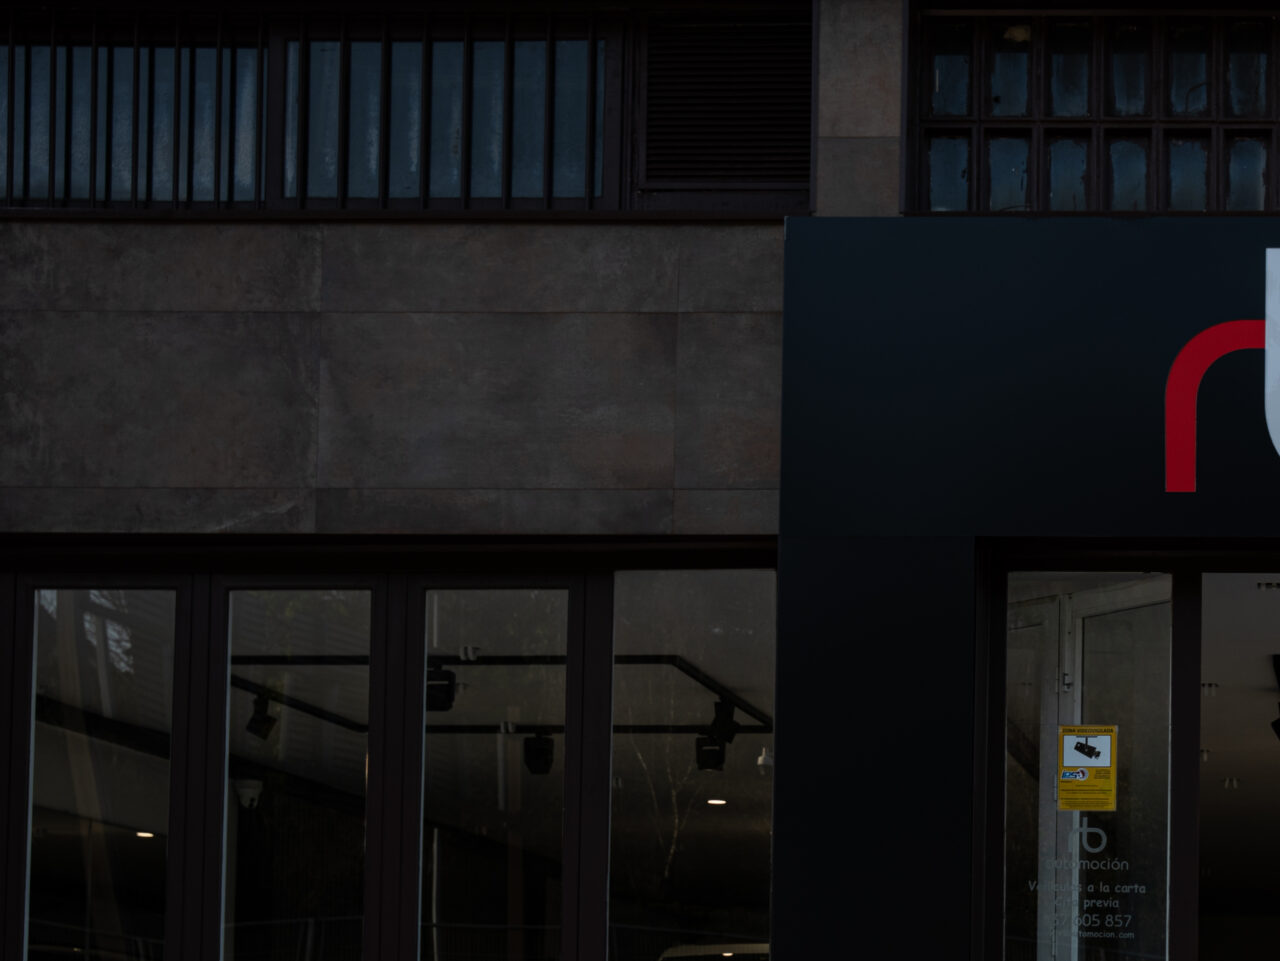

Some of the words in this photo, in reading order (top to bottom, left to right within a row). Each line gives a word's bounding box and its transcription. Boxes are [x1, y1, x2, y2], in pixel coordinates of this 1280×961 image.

[1087, 884, 1095, 892] a
[1100, 882, 1110, 893] la
[1114, 884, 1146, 894] carta
[1084, 897, 1119, 910] previa
[1105, 914, 1132, 928] 857
